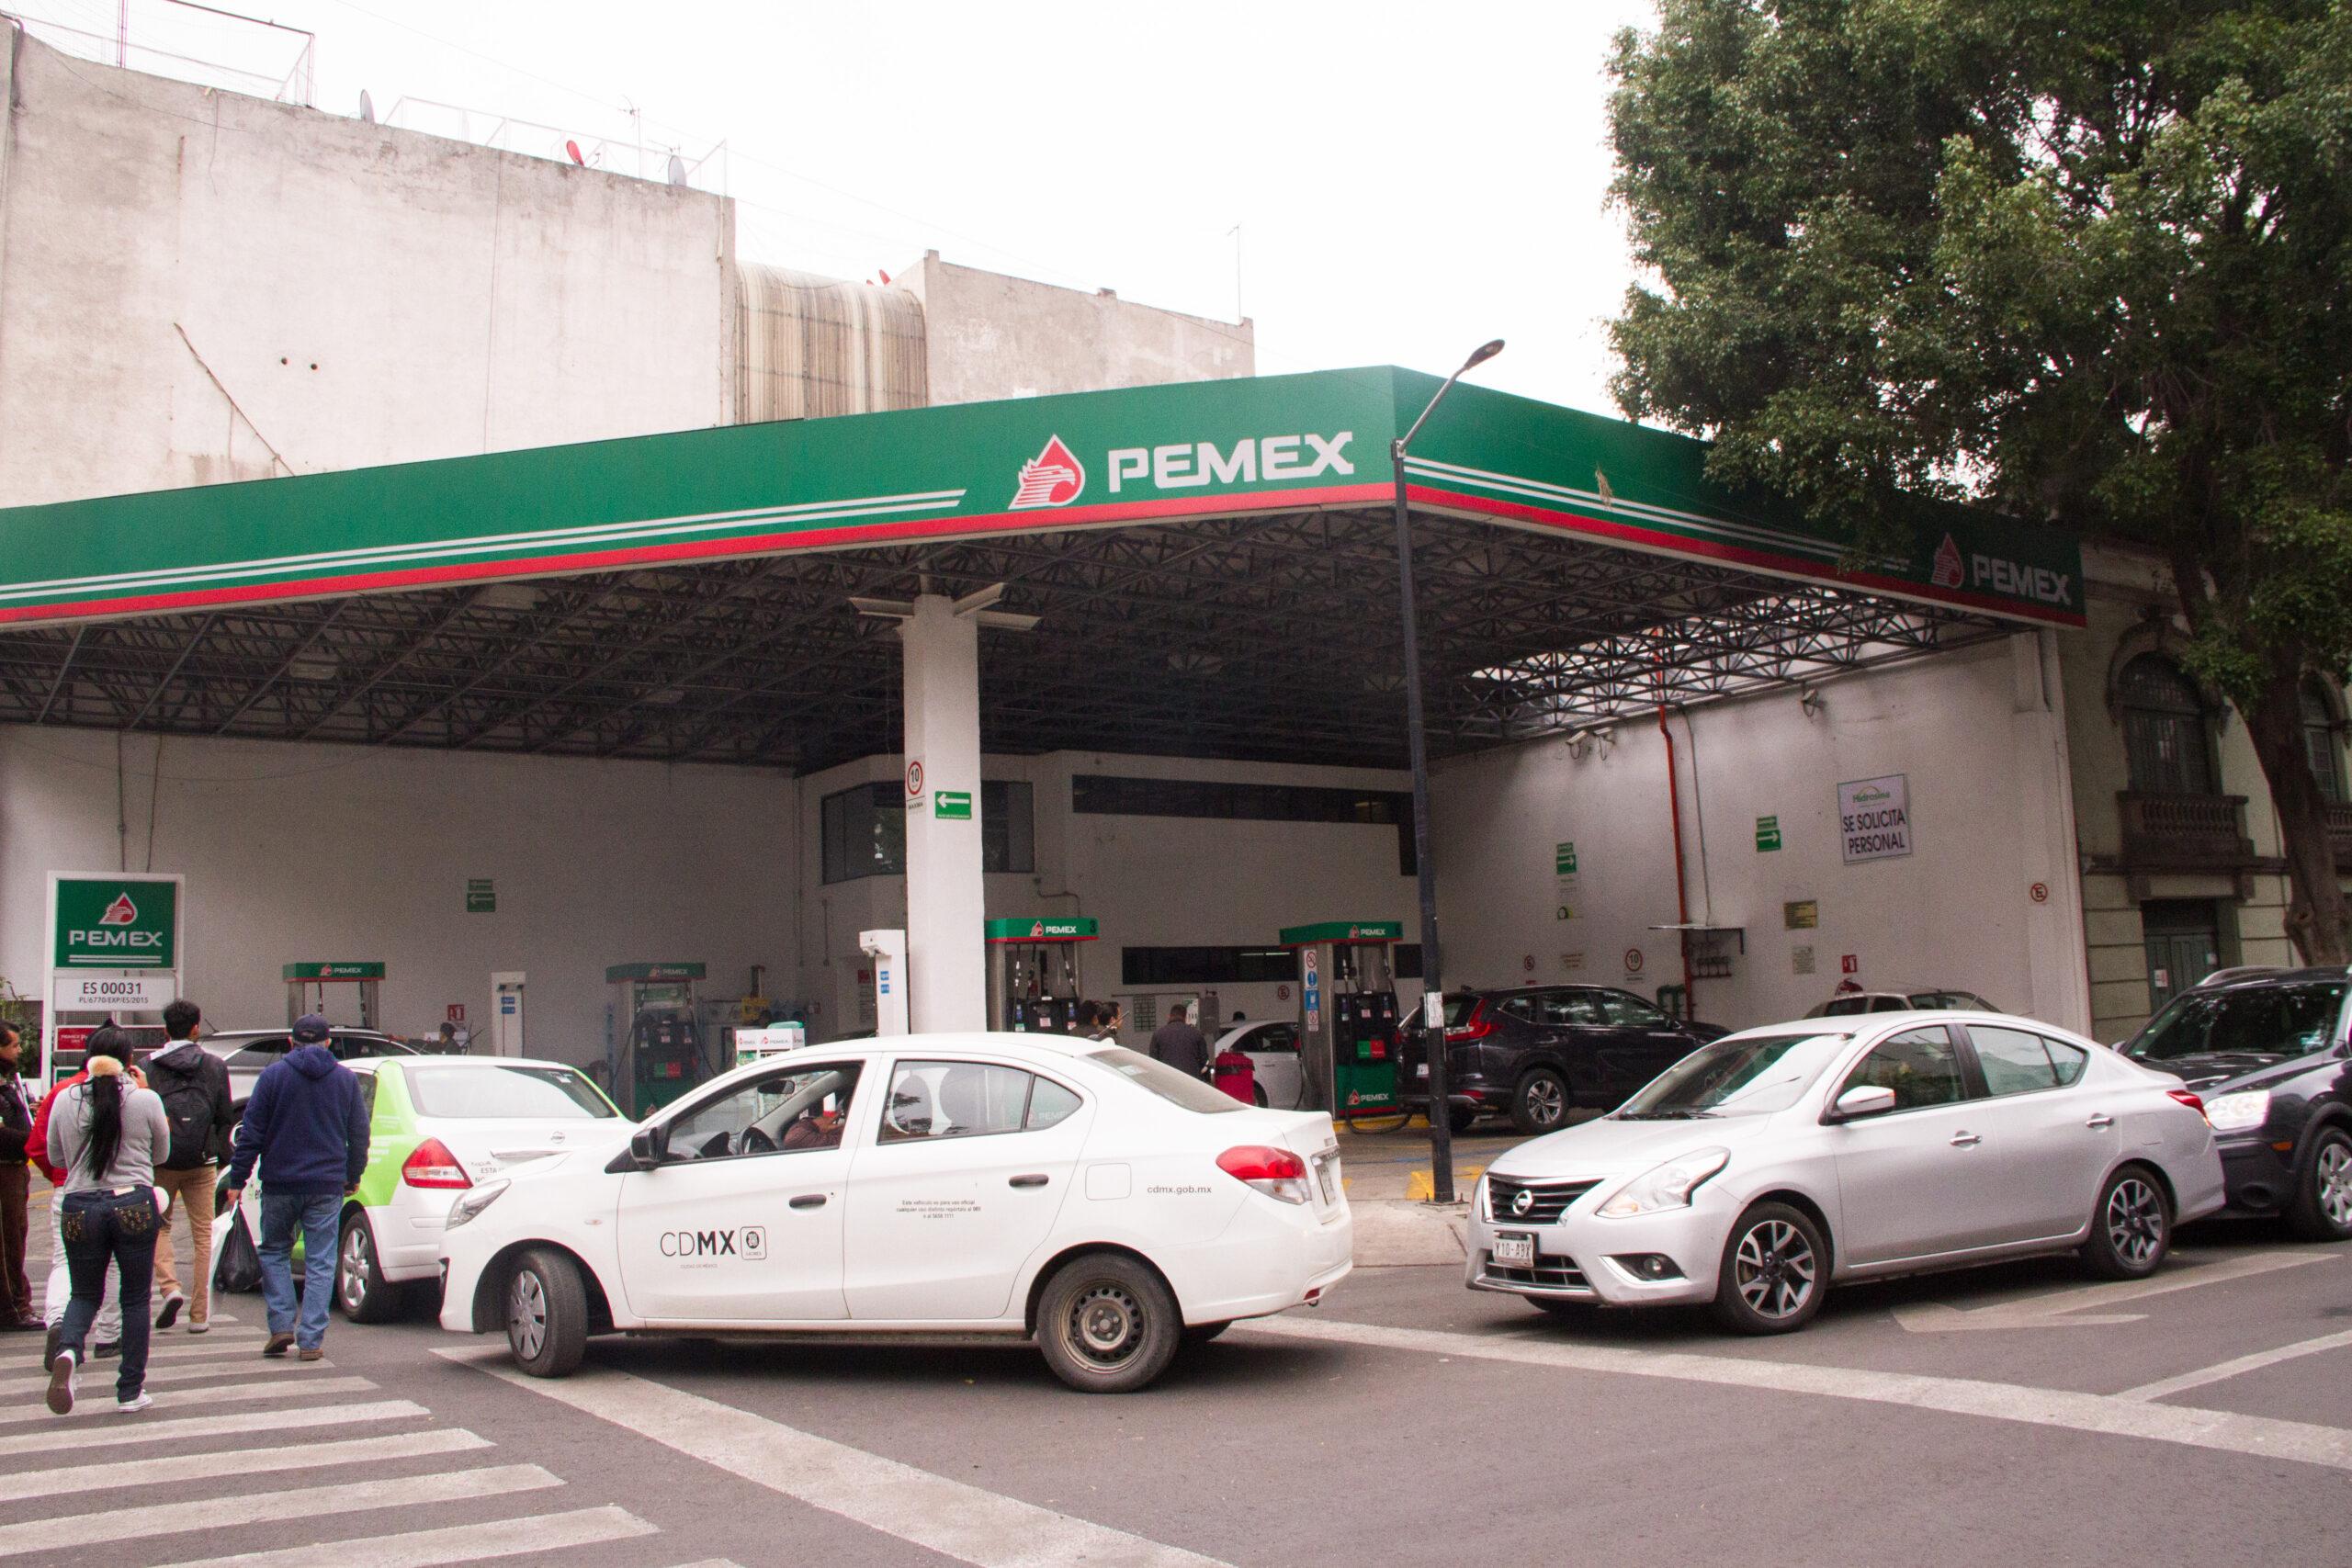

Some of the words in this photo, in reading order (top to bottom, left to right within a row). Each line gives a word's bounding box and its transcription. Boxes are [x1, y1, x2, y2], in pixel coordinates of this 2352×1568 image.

[1108, 431, 1354, 492] PEMEX
[1972, 553, 2072, 605] PEMEX
[1843, 815, 1855, 832] SE
[1857, 808, 1905, 830] SOLICITA
[1849, 831, 1905, 854] PERSONAL
[69, 930, 163, 947] PEMEX
[1046, 926, 1077, 934] PEMEX
[1361, 928, 1385, 936] PEMEX
[83, 982, 97, 995] ES
[101, 982, 141, 995] 00031
[1361, 1093, 1389, 1101] PEMEX
[1147, 1185, 1212, 1195] cdmx.gob.mx
[660, 1230, 736, 1258] CDMX
